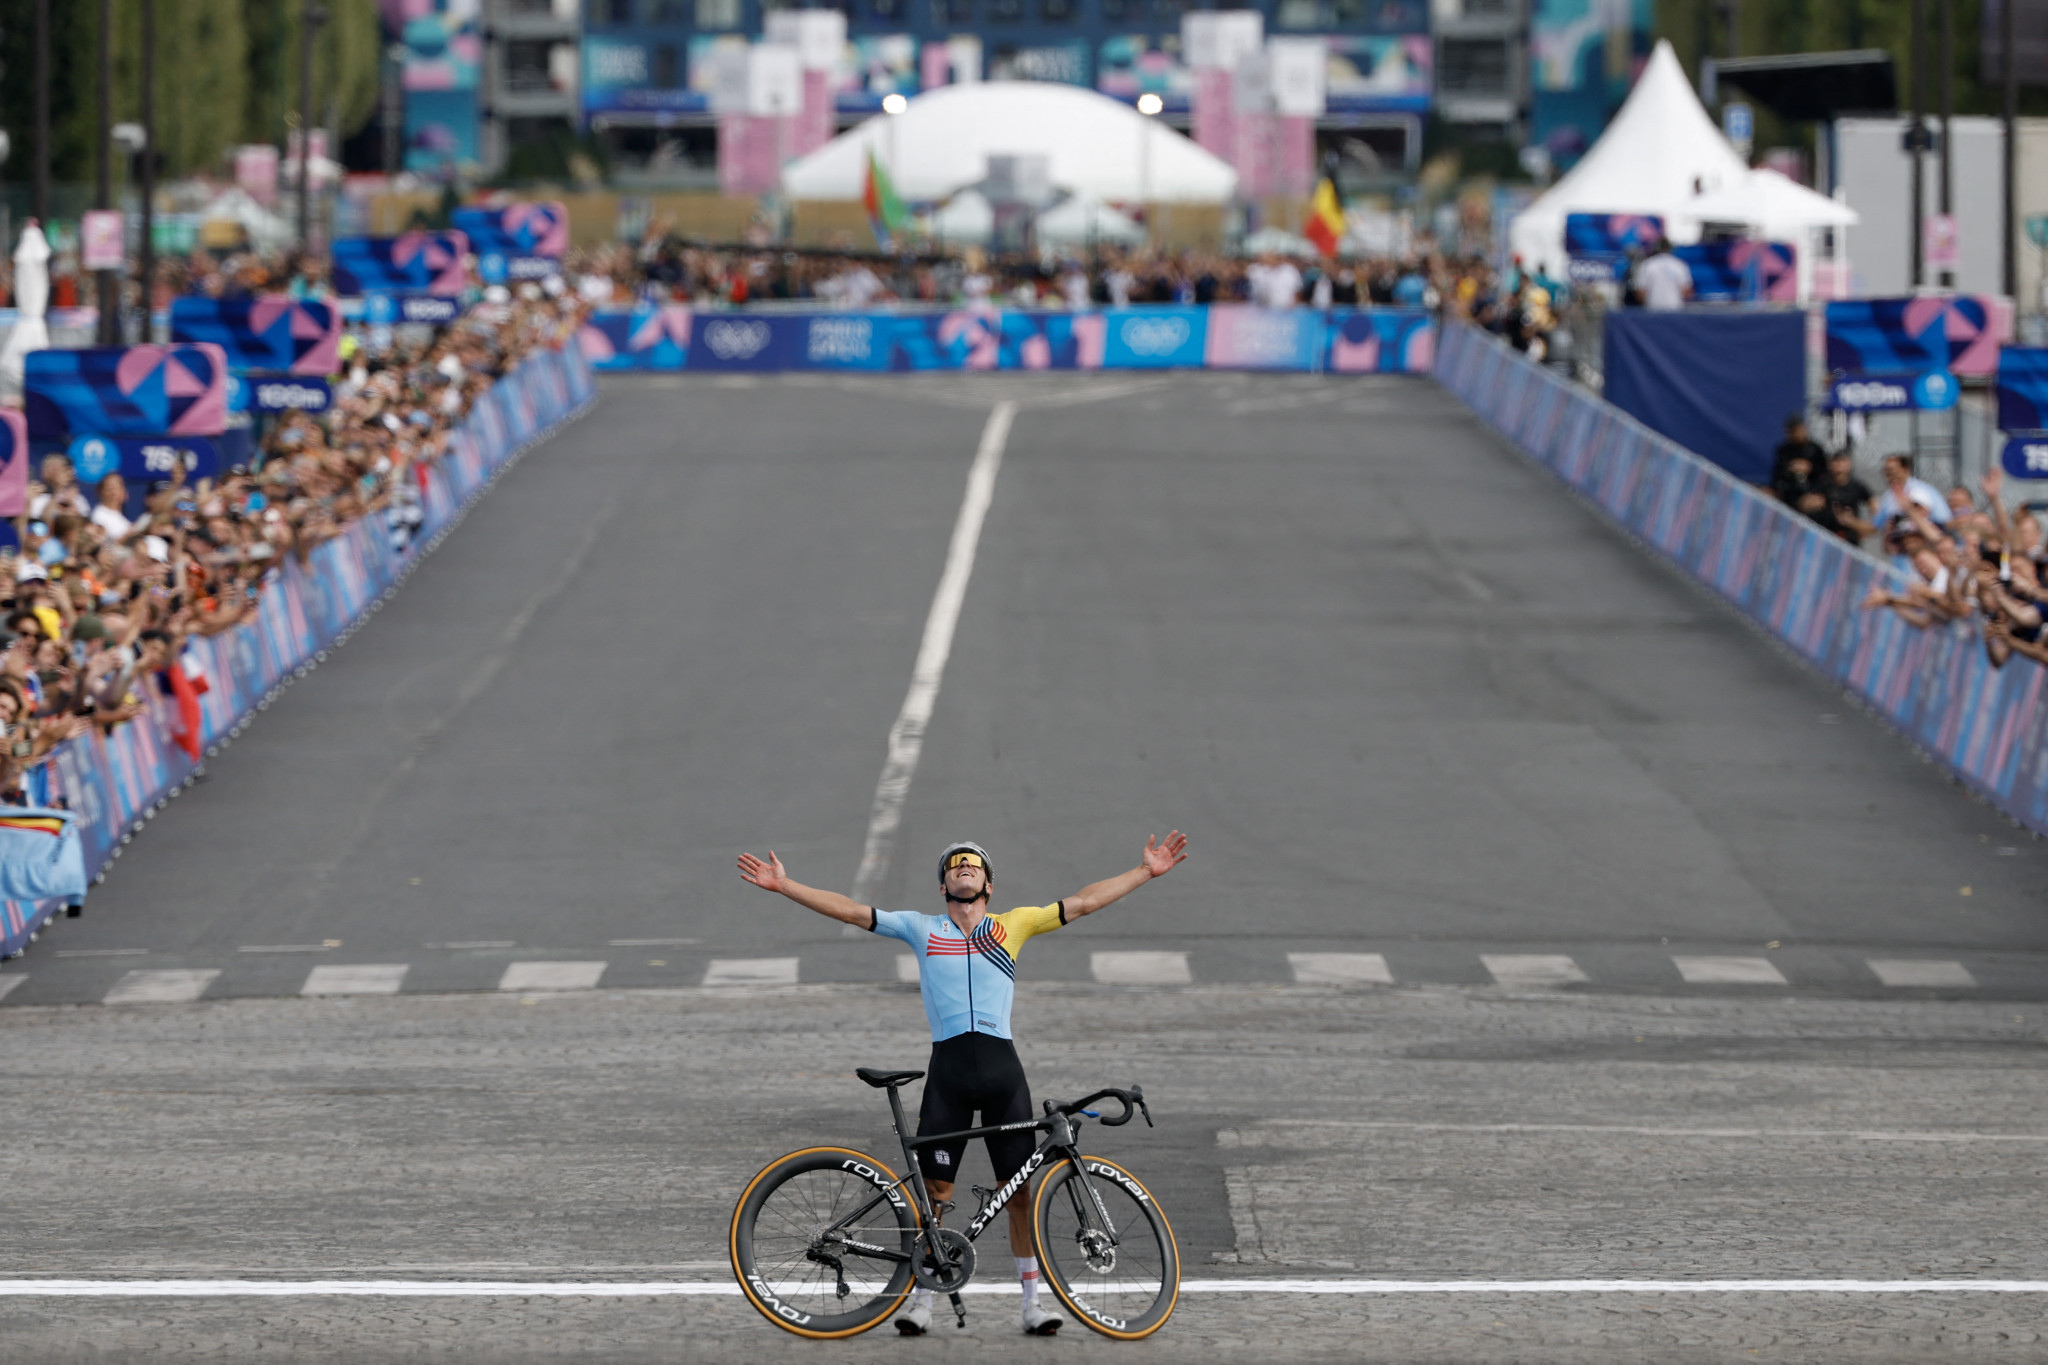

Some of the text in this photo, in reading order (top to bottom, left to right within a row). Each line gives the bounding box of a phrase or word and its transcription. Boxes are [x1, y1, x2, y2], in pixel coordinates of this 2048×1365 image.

[257, 383, 327, 409] 100m
[1836, 381, 1908, 407] 100m
[841, 1160, 907, 1208] roval
[970, 1147, 1044, 1237] S-WORKS
[1090, 1163, 1149, 1201] roval
[747, 1274, 811, 1325] roval
[1067, 1292, 1126, 1330] roval
